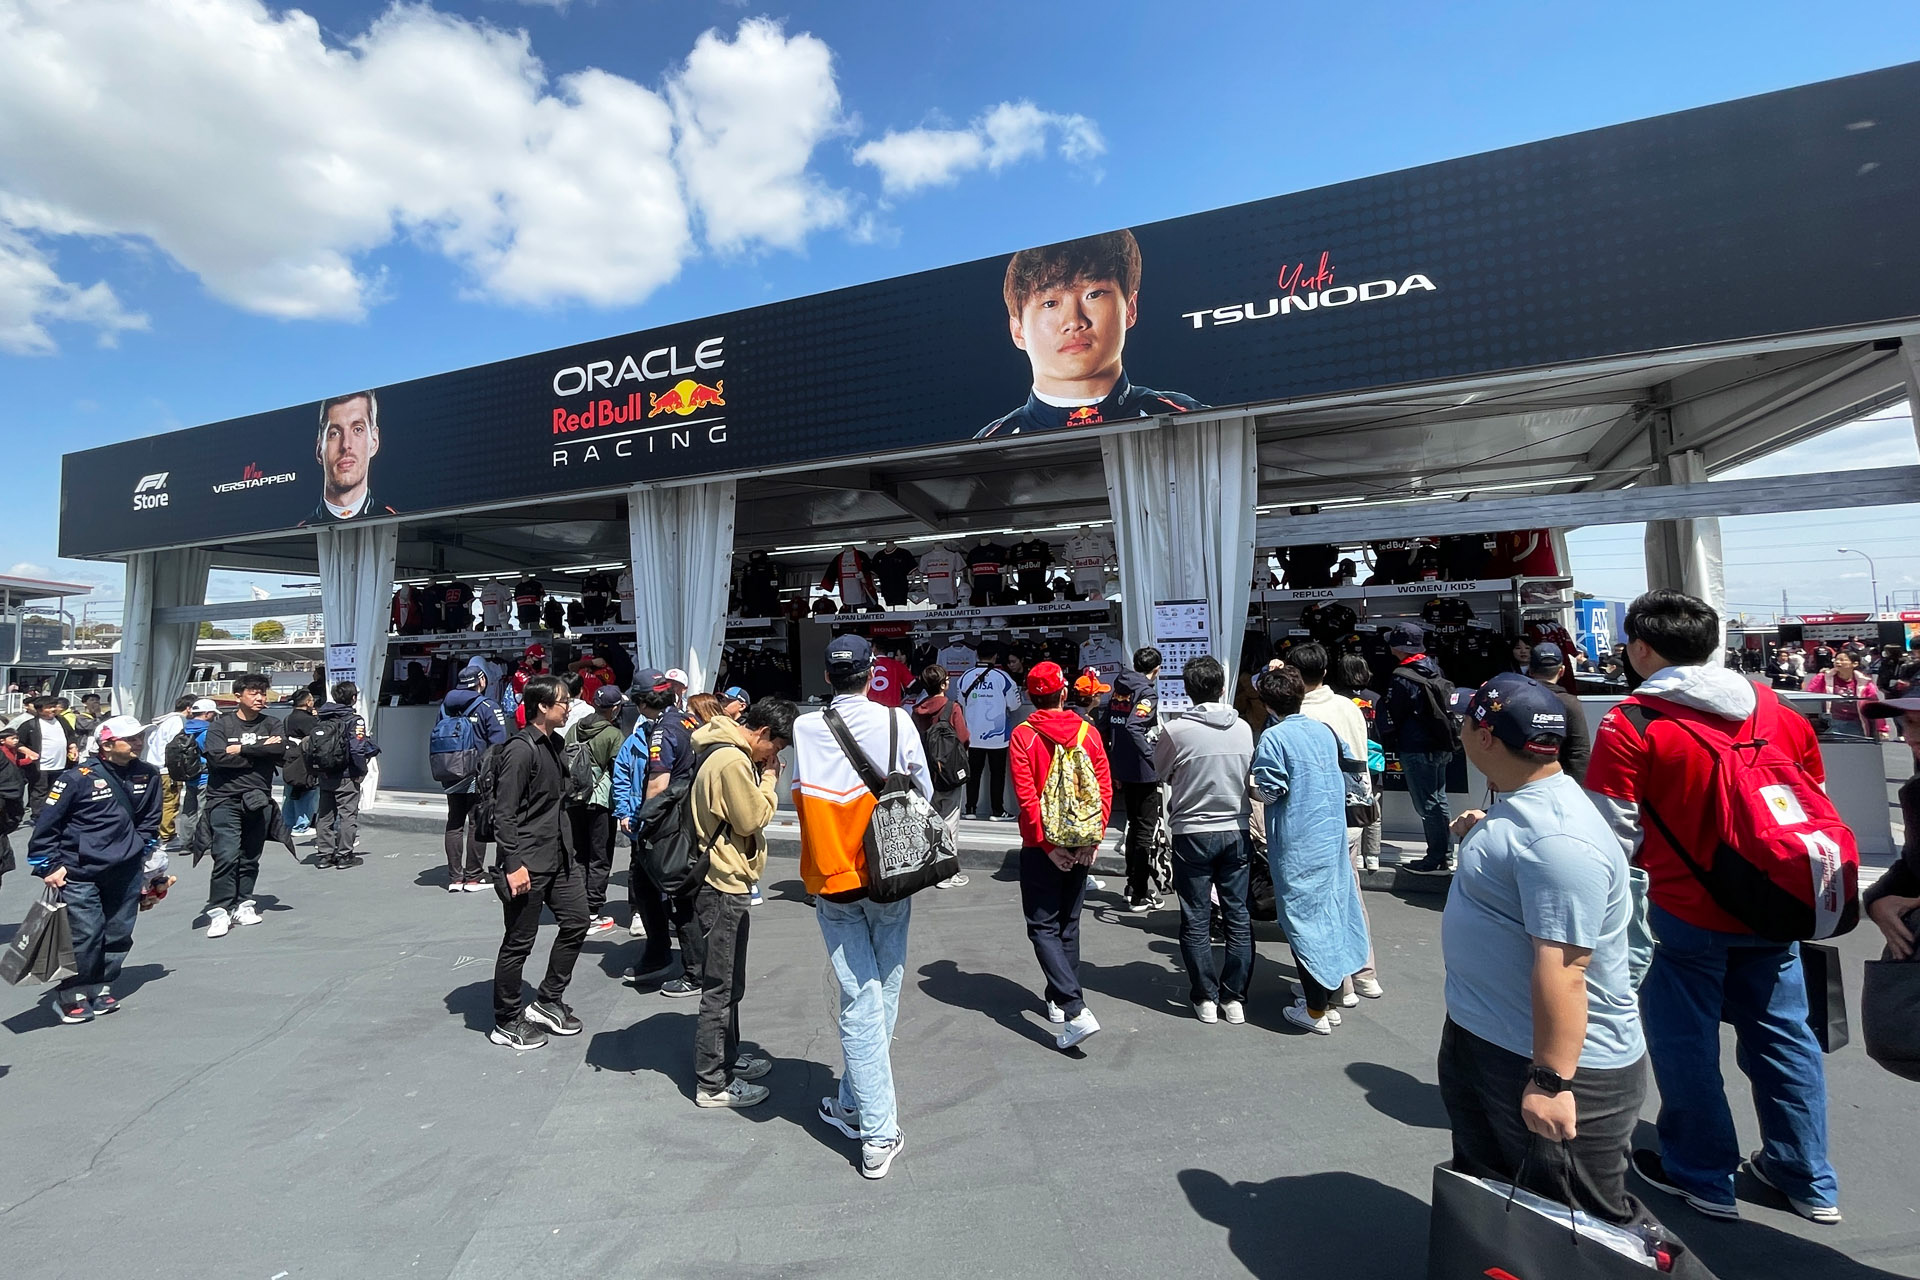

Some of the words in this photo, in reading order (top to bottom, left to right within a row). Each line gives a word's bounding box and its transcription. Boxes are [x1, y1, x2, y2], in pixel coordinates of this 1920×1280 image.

[1278, 251, 1336, 303] Yuki
[1181, 274, 1437, 329] TSUNODA
[553, 336, 725, 396] ORACLE
[553, 400, 595, 434] Red
[598, 392, 641, 427] Bull
[553, 424, 727, 467] RACING
[243, 462, 263, 480] Max
[213, 472, 296, 493] VERSTAPPEN
[133, 493, 169, 511] Store
[1292, 590, 1334, 598] REPLICA
[1397, 584, 1442, 593] WOMEN
[1450, 582, 1476, 590] KIDS
[950, 609, 981, 617] LIMITED
[1038, 603, 1072, 611] REPLICA
[881, 816, 896, 827] La
[884, 841, 906, 854] esta
